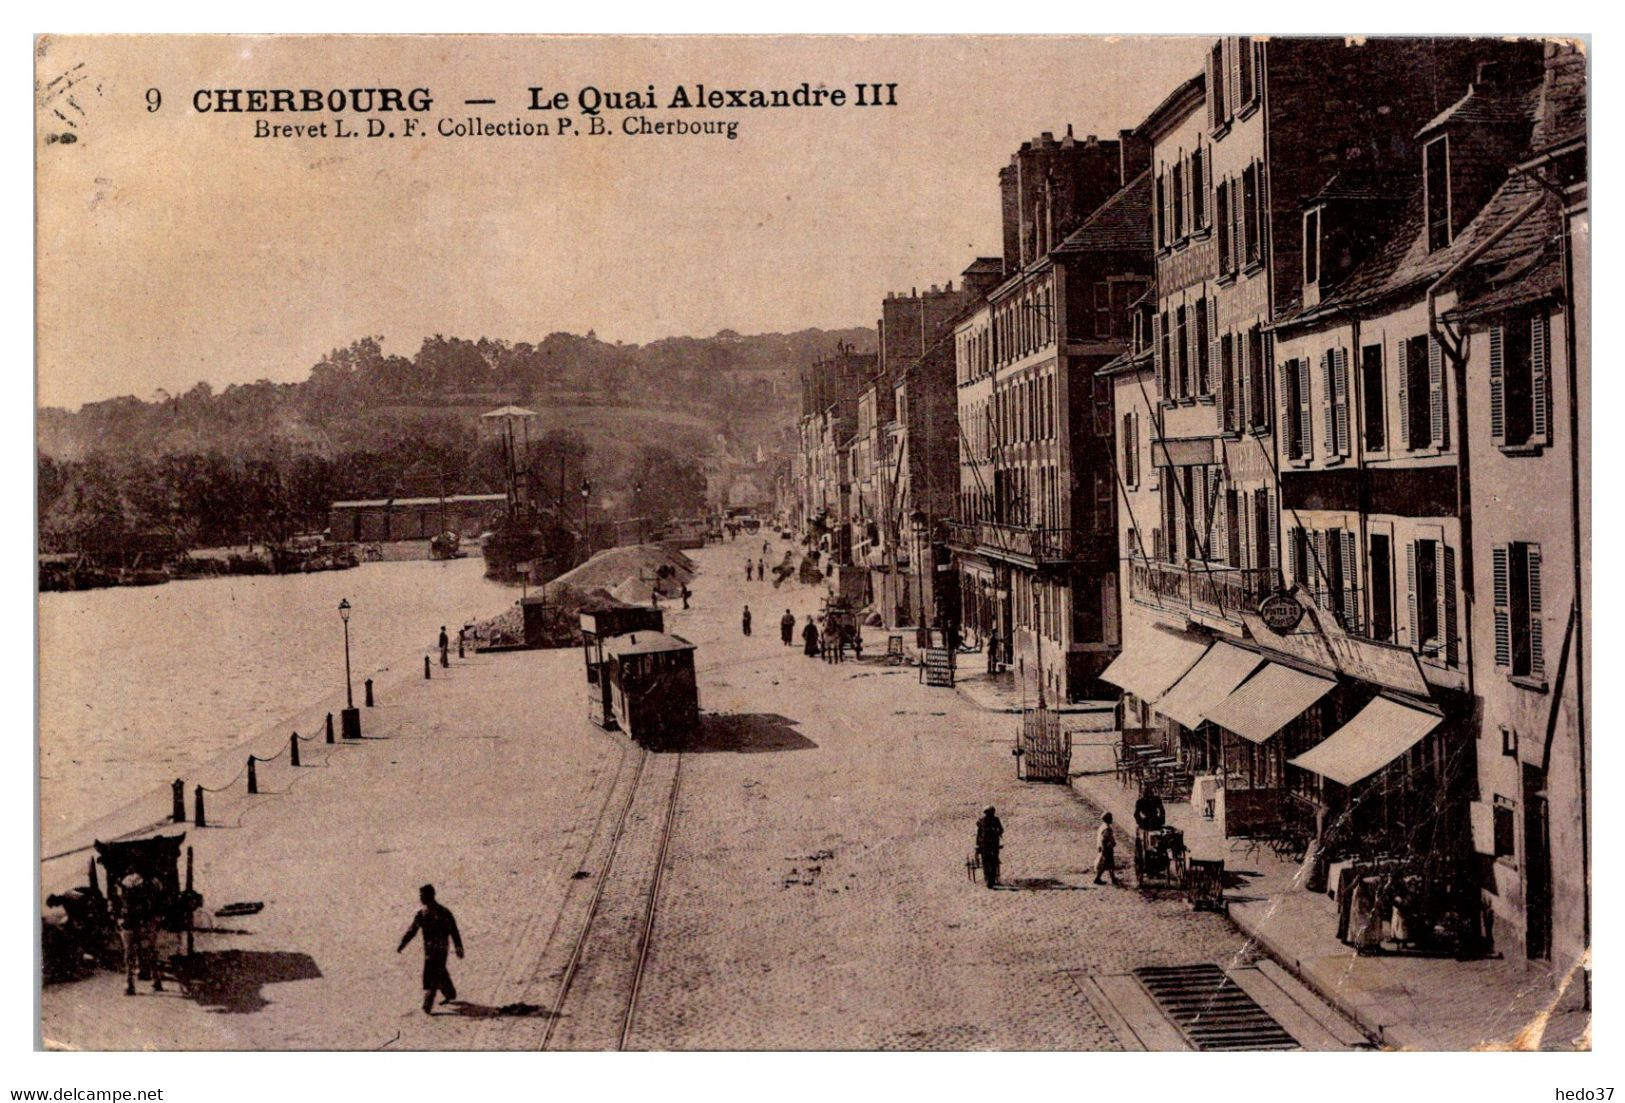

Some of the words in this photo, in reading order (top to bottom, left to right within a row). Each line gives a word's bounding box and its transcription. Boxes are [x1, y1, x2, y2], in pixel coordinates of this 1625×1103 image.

[145, 87, 162, 113] 9
[192, 88, 434, 113] CHERBOURG
[527, 86, 569, 111] Le
[577, 84, 658, 115] Quai
[667, 82, 847, 109] Alexandre
[854, 83, 898, 107] III
[253, 119, 328, 138] Brevet
[334, 119, 359, 138] L.
[366, 118, 395, 139] D.
[403, 118, 426, 137] F.
[437, 116, 550, 137] Collection
[557, 117, 579, 137] P.
[588, 116, 613, 136] B.
[622, 115, 739, 140] Cherbourg
